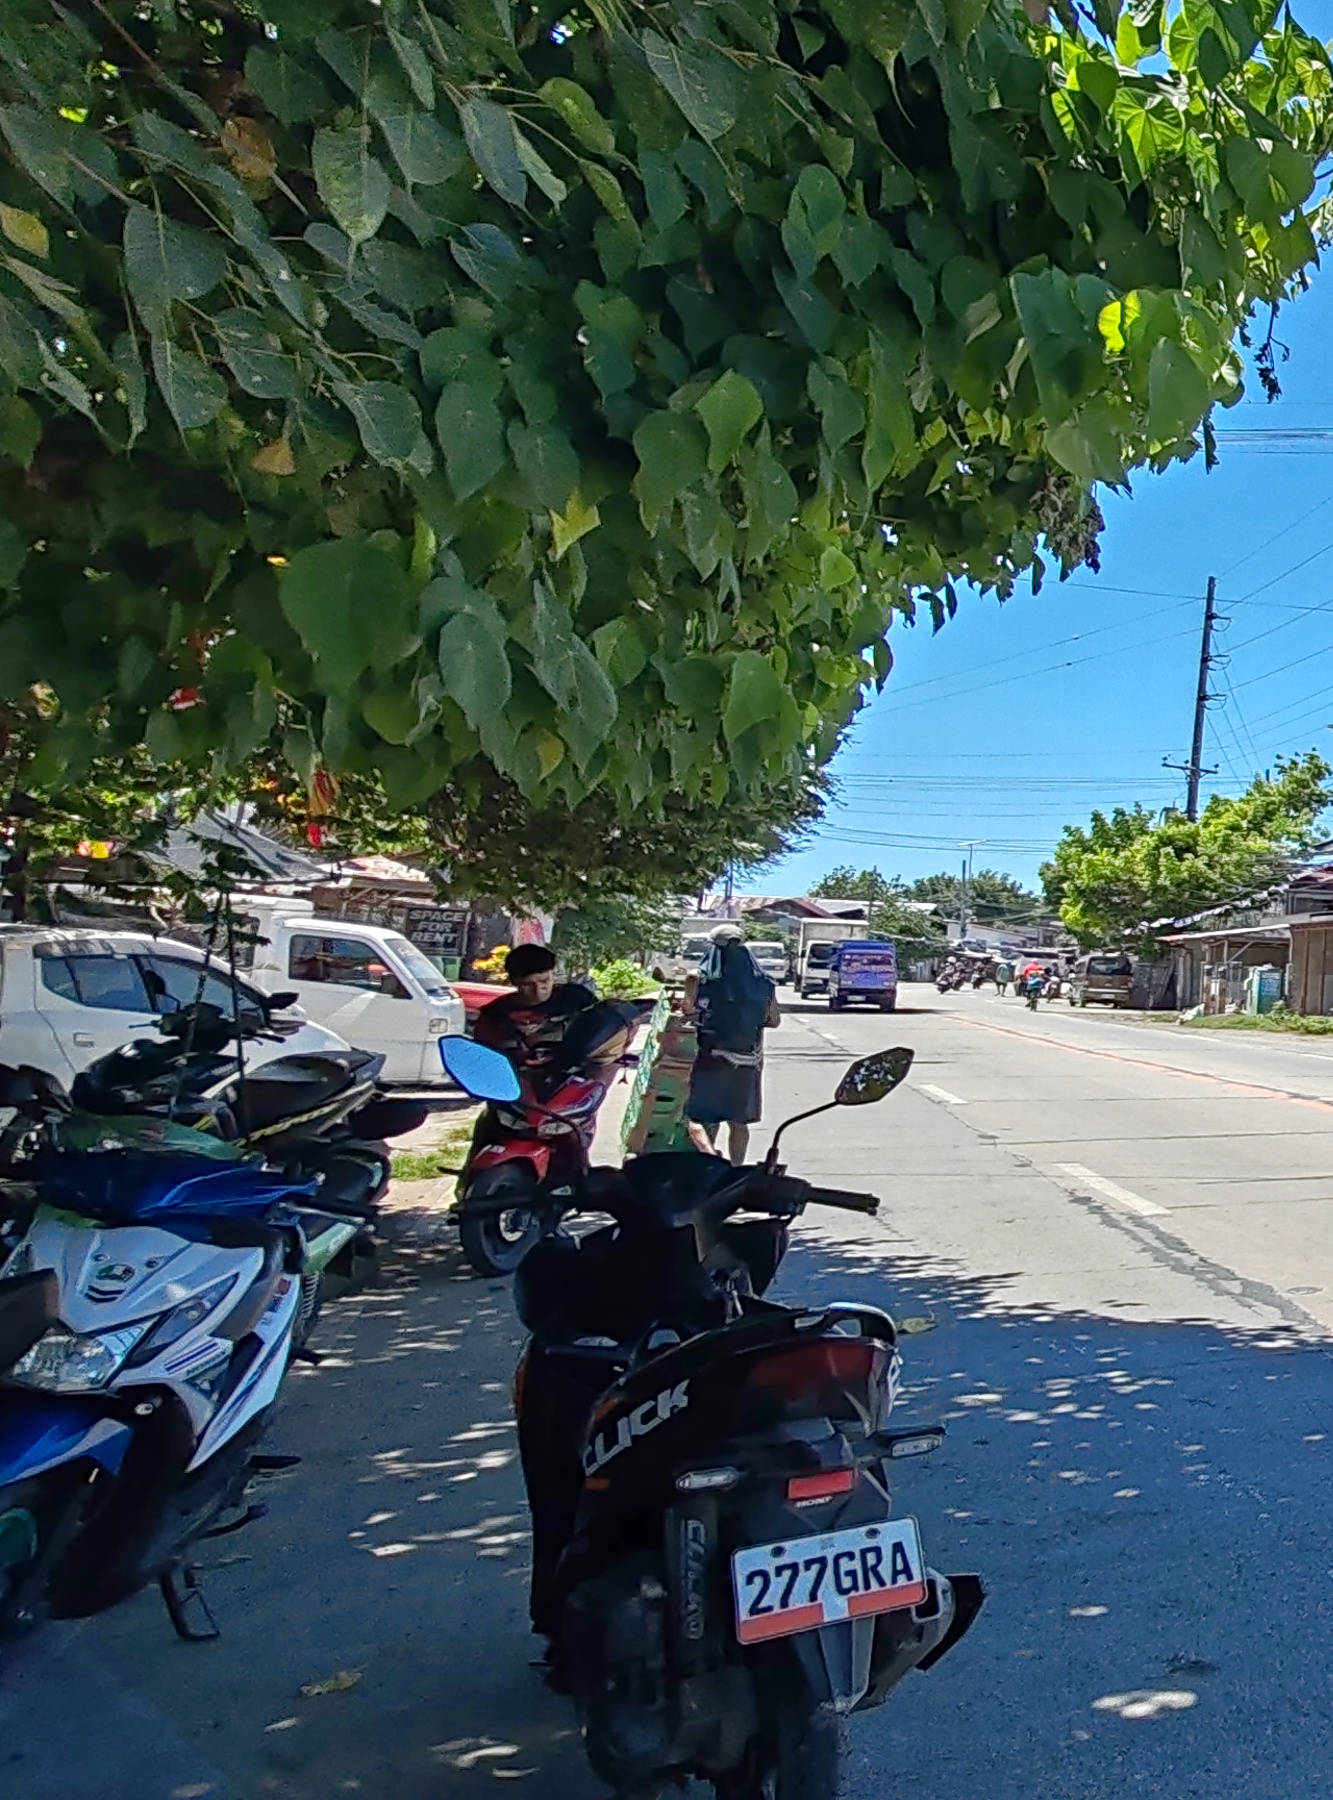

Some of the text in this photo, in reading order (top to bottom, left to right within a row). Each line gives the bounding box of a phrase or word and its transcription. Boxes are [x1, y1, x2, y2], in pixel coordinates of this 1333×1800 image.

[409, 910, 466, 922] SPACE
[418, 921, 453, 932] FOR
[410, 931, 458, 943] RENT
[582, 1378, 691, 1477] CLICK
[745, 1541, 915, 1617] 277GRA
